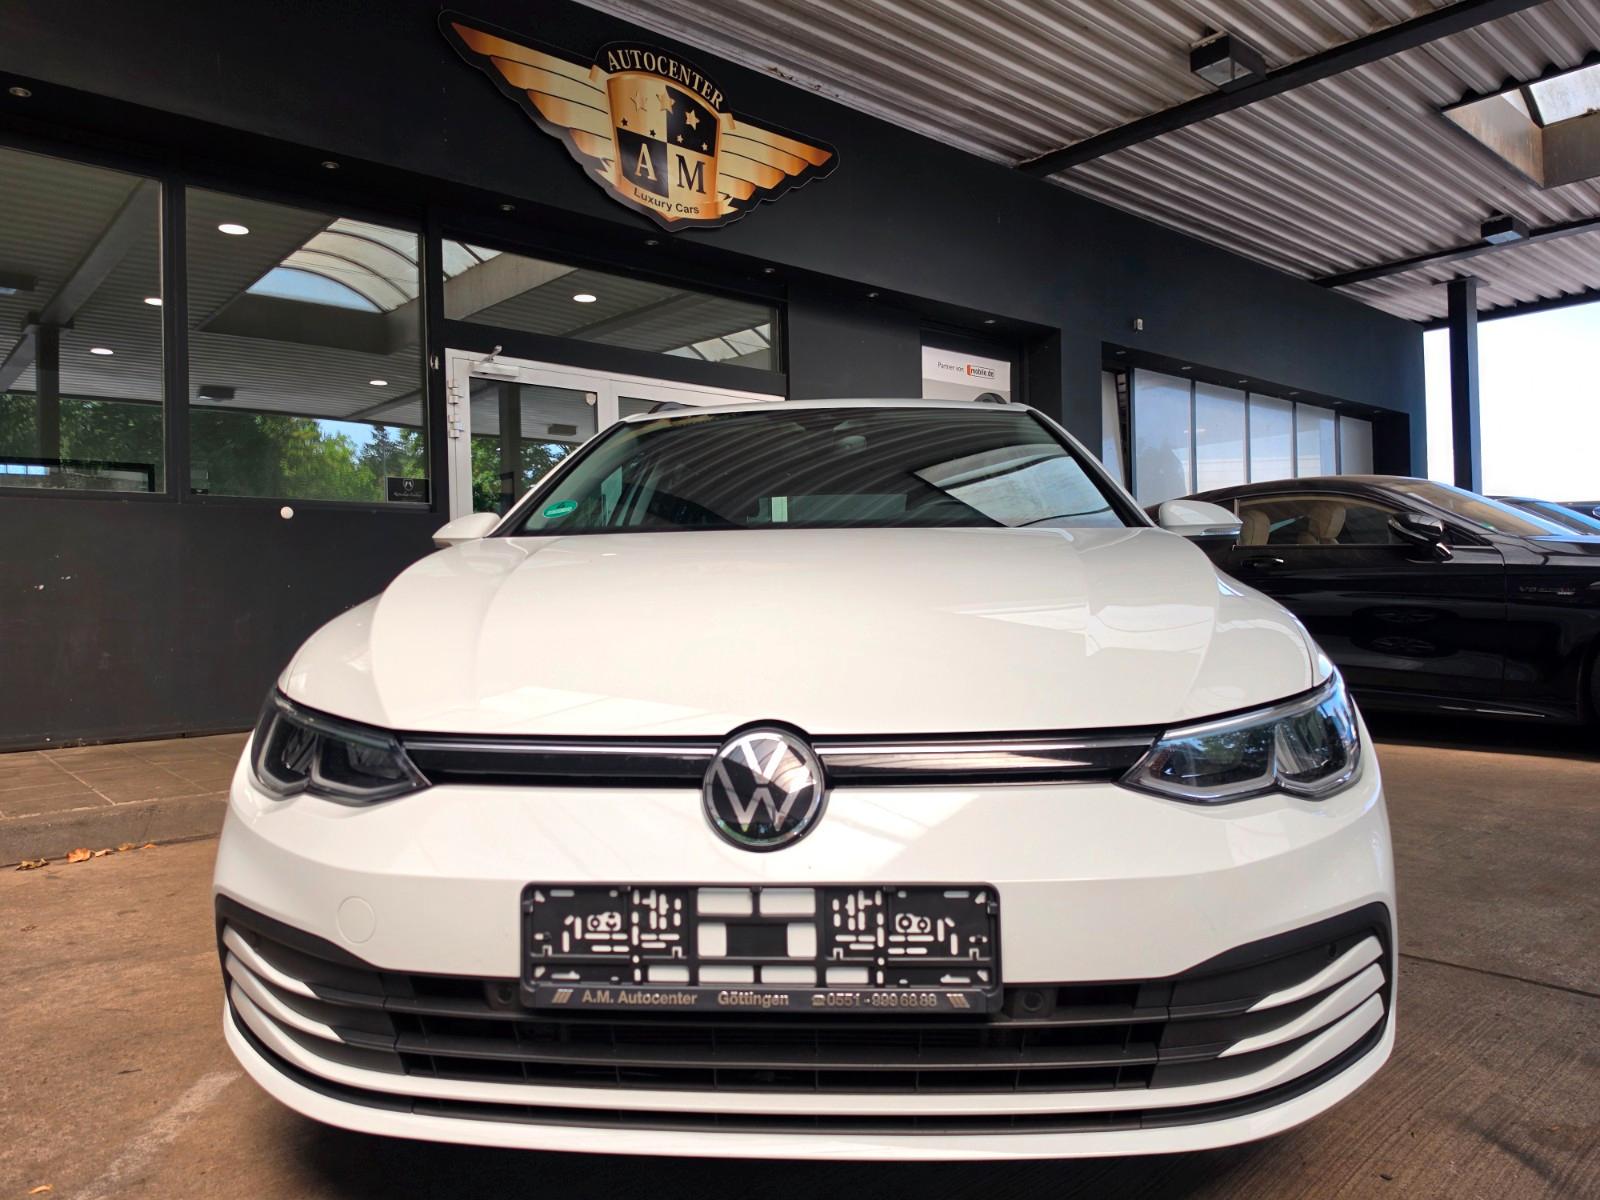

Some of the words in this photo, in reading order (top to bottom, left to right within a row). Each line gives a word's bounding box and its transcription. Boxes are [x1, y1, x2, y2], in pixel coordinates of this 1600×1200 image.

[607, 49, 724, 111] AUTOCENTER
[634, 143, 658, 181] A
[676, 153, 706, 195] M
[633, 187, 673, 212] Luxury
[675, 203, 700, 215] Cars
[582, 990, 615, 1004] A.M.
[618, 990, 698, 1005] Autocenter
[717, 990, 790, 1008] Göttingen
